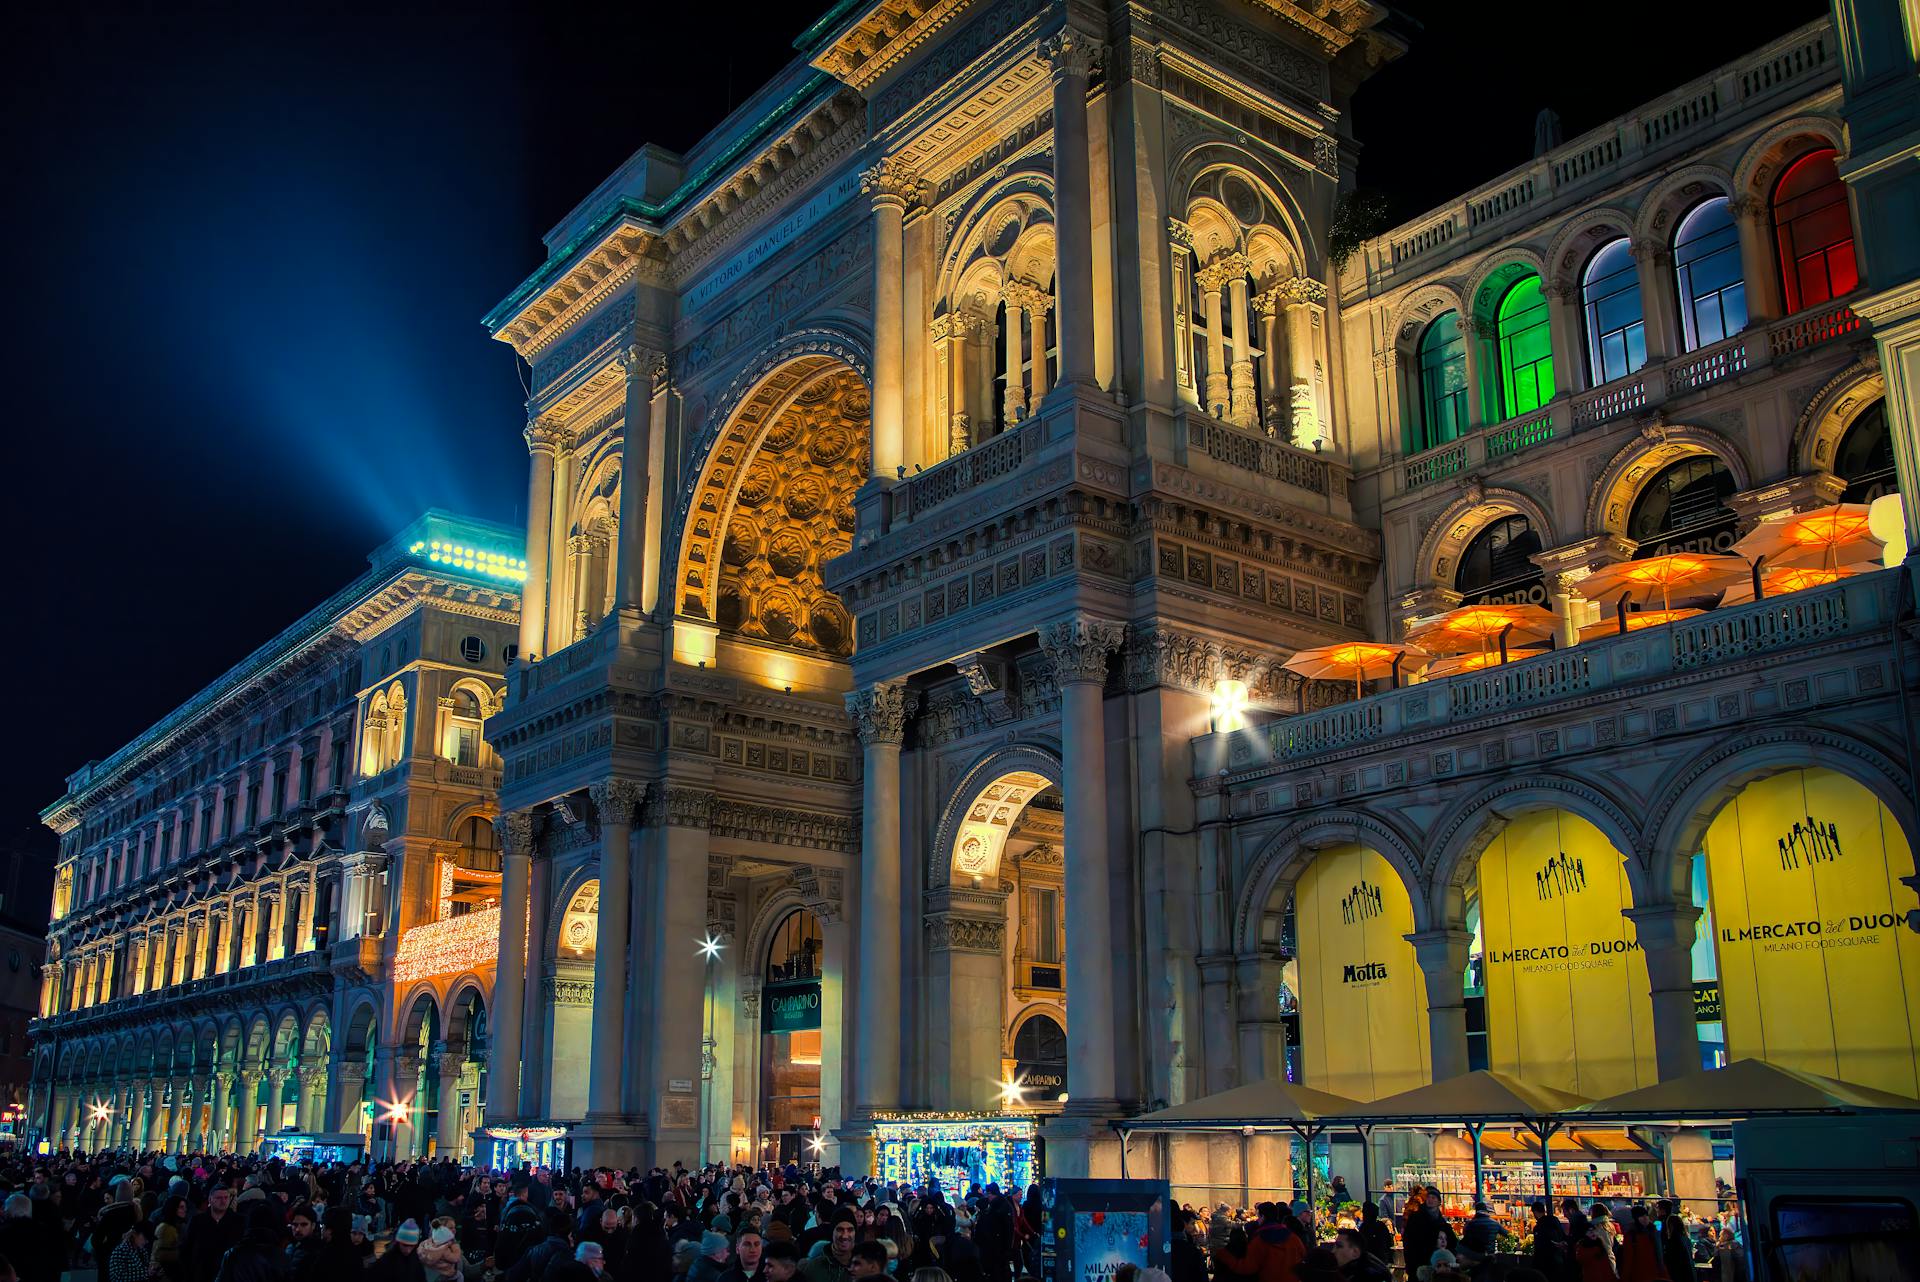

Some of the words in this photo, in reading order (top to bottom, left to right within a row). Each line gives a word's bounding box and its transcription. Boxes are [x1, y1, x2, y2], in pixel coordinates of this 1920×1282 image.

[687, 295, 695, 309] A
[700, 260, 743, 298] VITTORIO
[747, 214, 804, 265] EMANUELE
[838, 177, 859, 197] MIL
[1722, 928, 1735, 942] IL
[1739, 921, 1821, 941] MERCATO
[1825, 918, 1846, 934] del
[1850, 913, 1909, 932] DUOM
[1489, 951, 1500, 963] IL
[1502, 946, 1569, 963] MERCATO
[1572, 943, 1588, 957] del
[1590, 940, 1639, 955] DUOM
[1764, 941, 1803, 953] MILANO
[1805, 939, 1836, 951] FOOD
[1838, 935, 1880, 947] SQUARE
[1343, 962, 1387, 983] Motta
[1522, 963, 1553, 974] MILANO
[1555, 961, 1579, 972] FOOD
[1581, 958, 1614, 970] SQUARE
[771, 993, 818, 1013] CAMPARINO
[1693, 989, 1719, 1003] CAT
[1021, 1073, 1062, 1086] CAMPARINO
